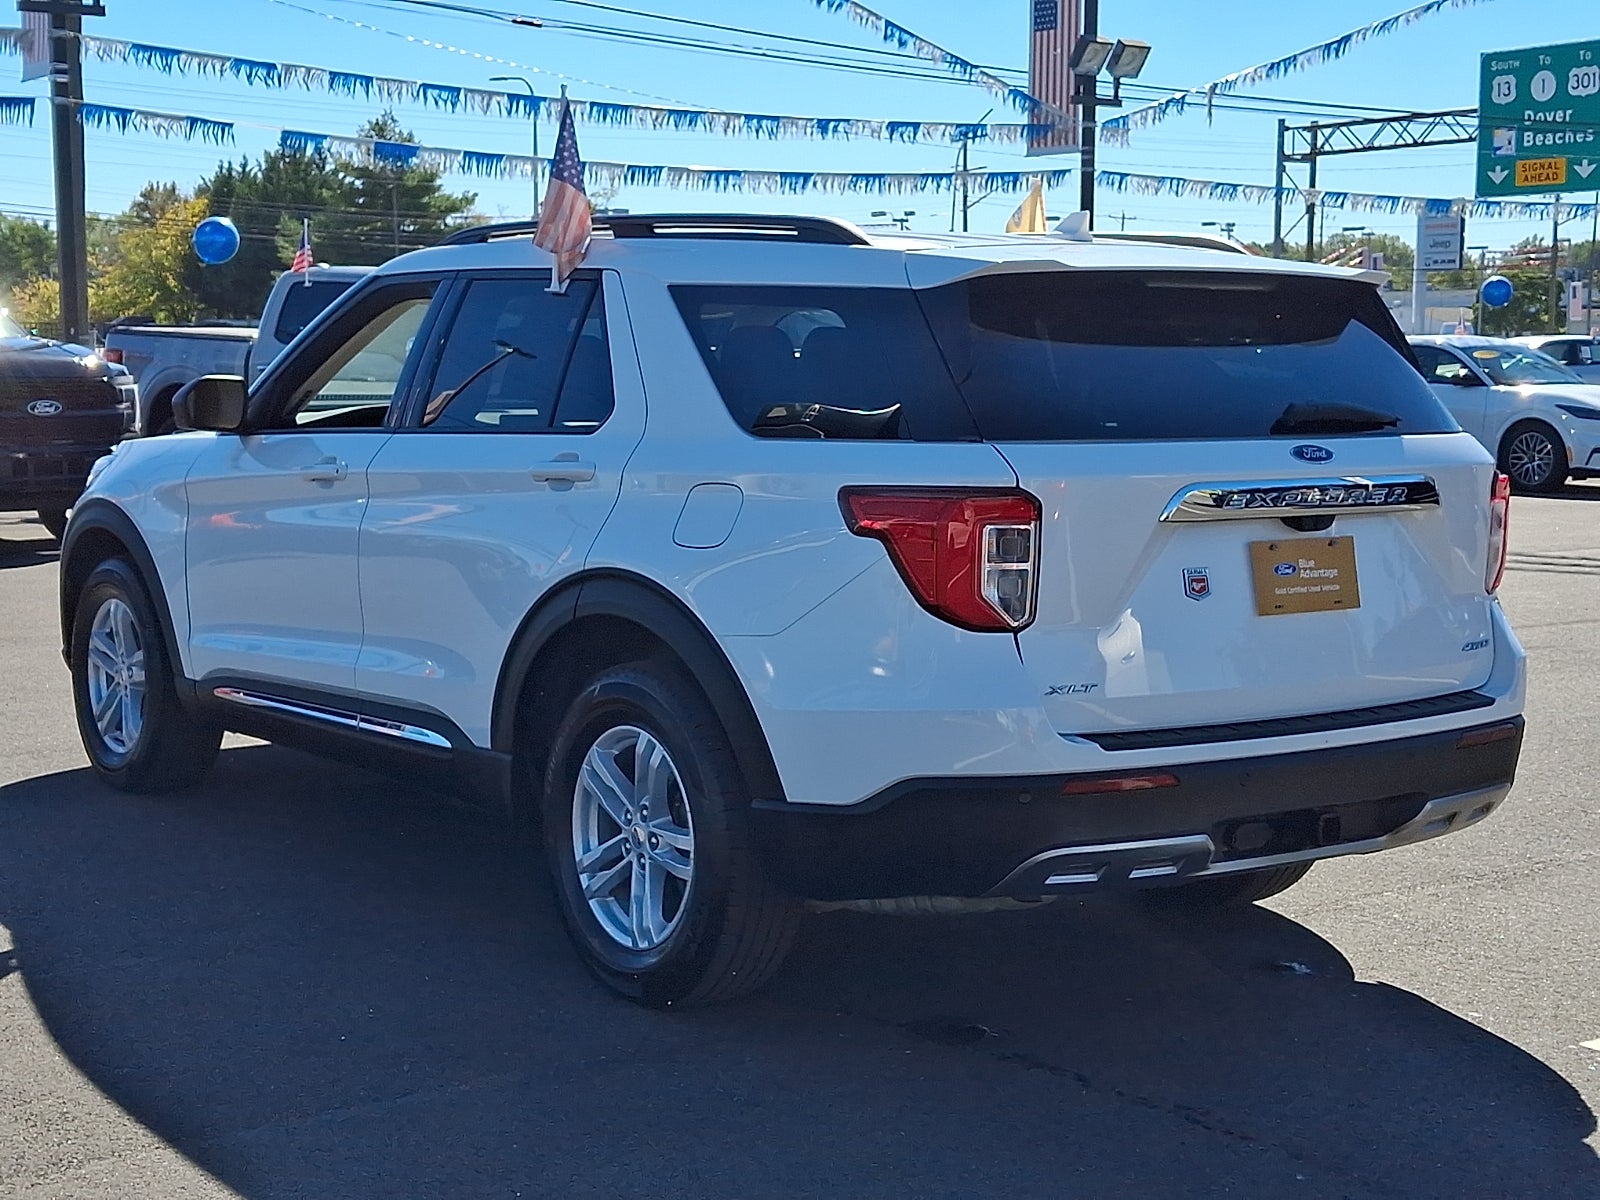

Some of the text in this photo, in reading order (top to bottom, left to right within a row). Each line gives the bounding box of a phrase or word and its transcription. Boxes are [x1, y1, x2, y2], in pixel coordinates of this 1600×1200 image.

[1571, 72, 1597, 90] 301
[1497, 81, 1512, 97] 13
[1524, 109, 1573, 125] Dover
[1523, 130, 1595, 147] Beaches
[1521, 161, 1560, 173] SIGNAL
[1522, 171, 1559, 183] AHEAD
[1223, 486, 1408, 509] EXPLORER
[1298, 559, 1315, 568] Blue
[1300, 568, 1338, 578] Advantage
[1044, 684, 1098, 696] XLT
